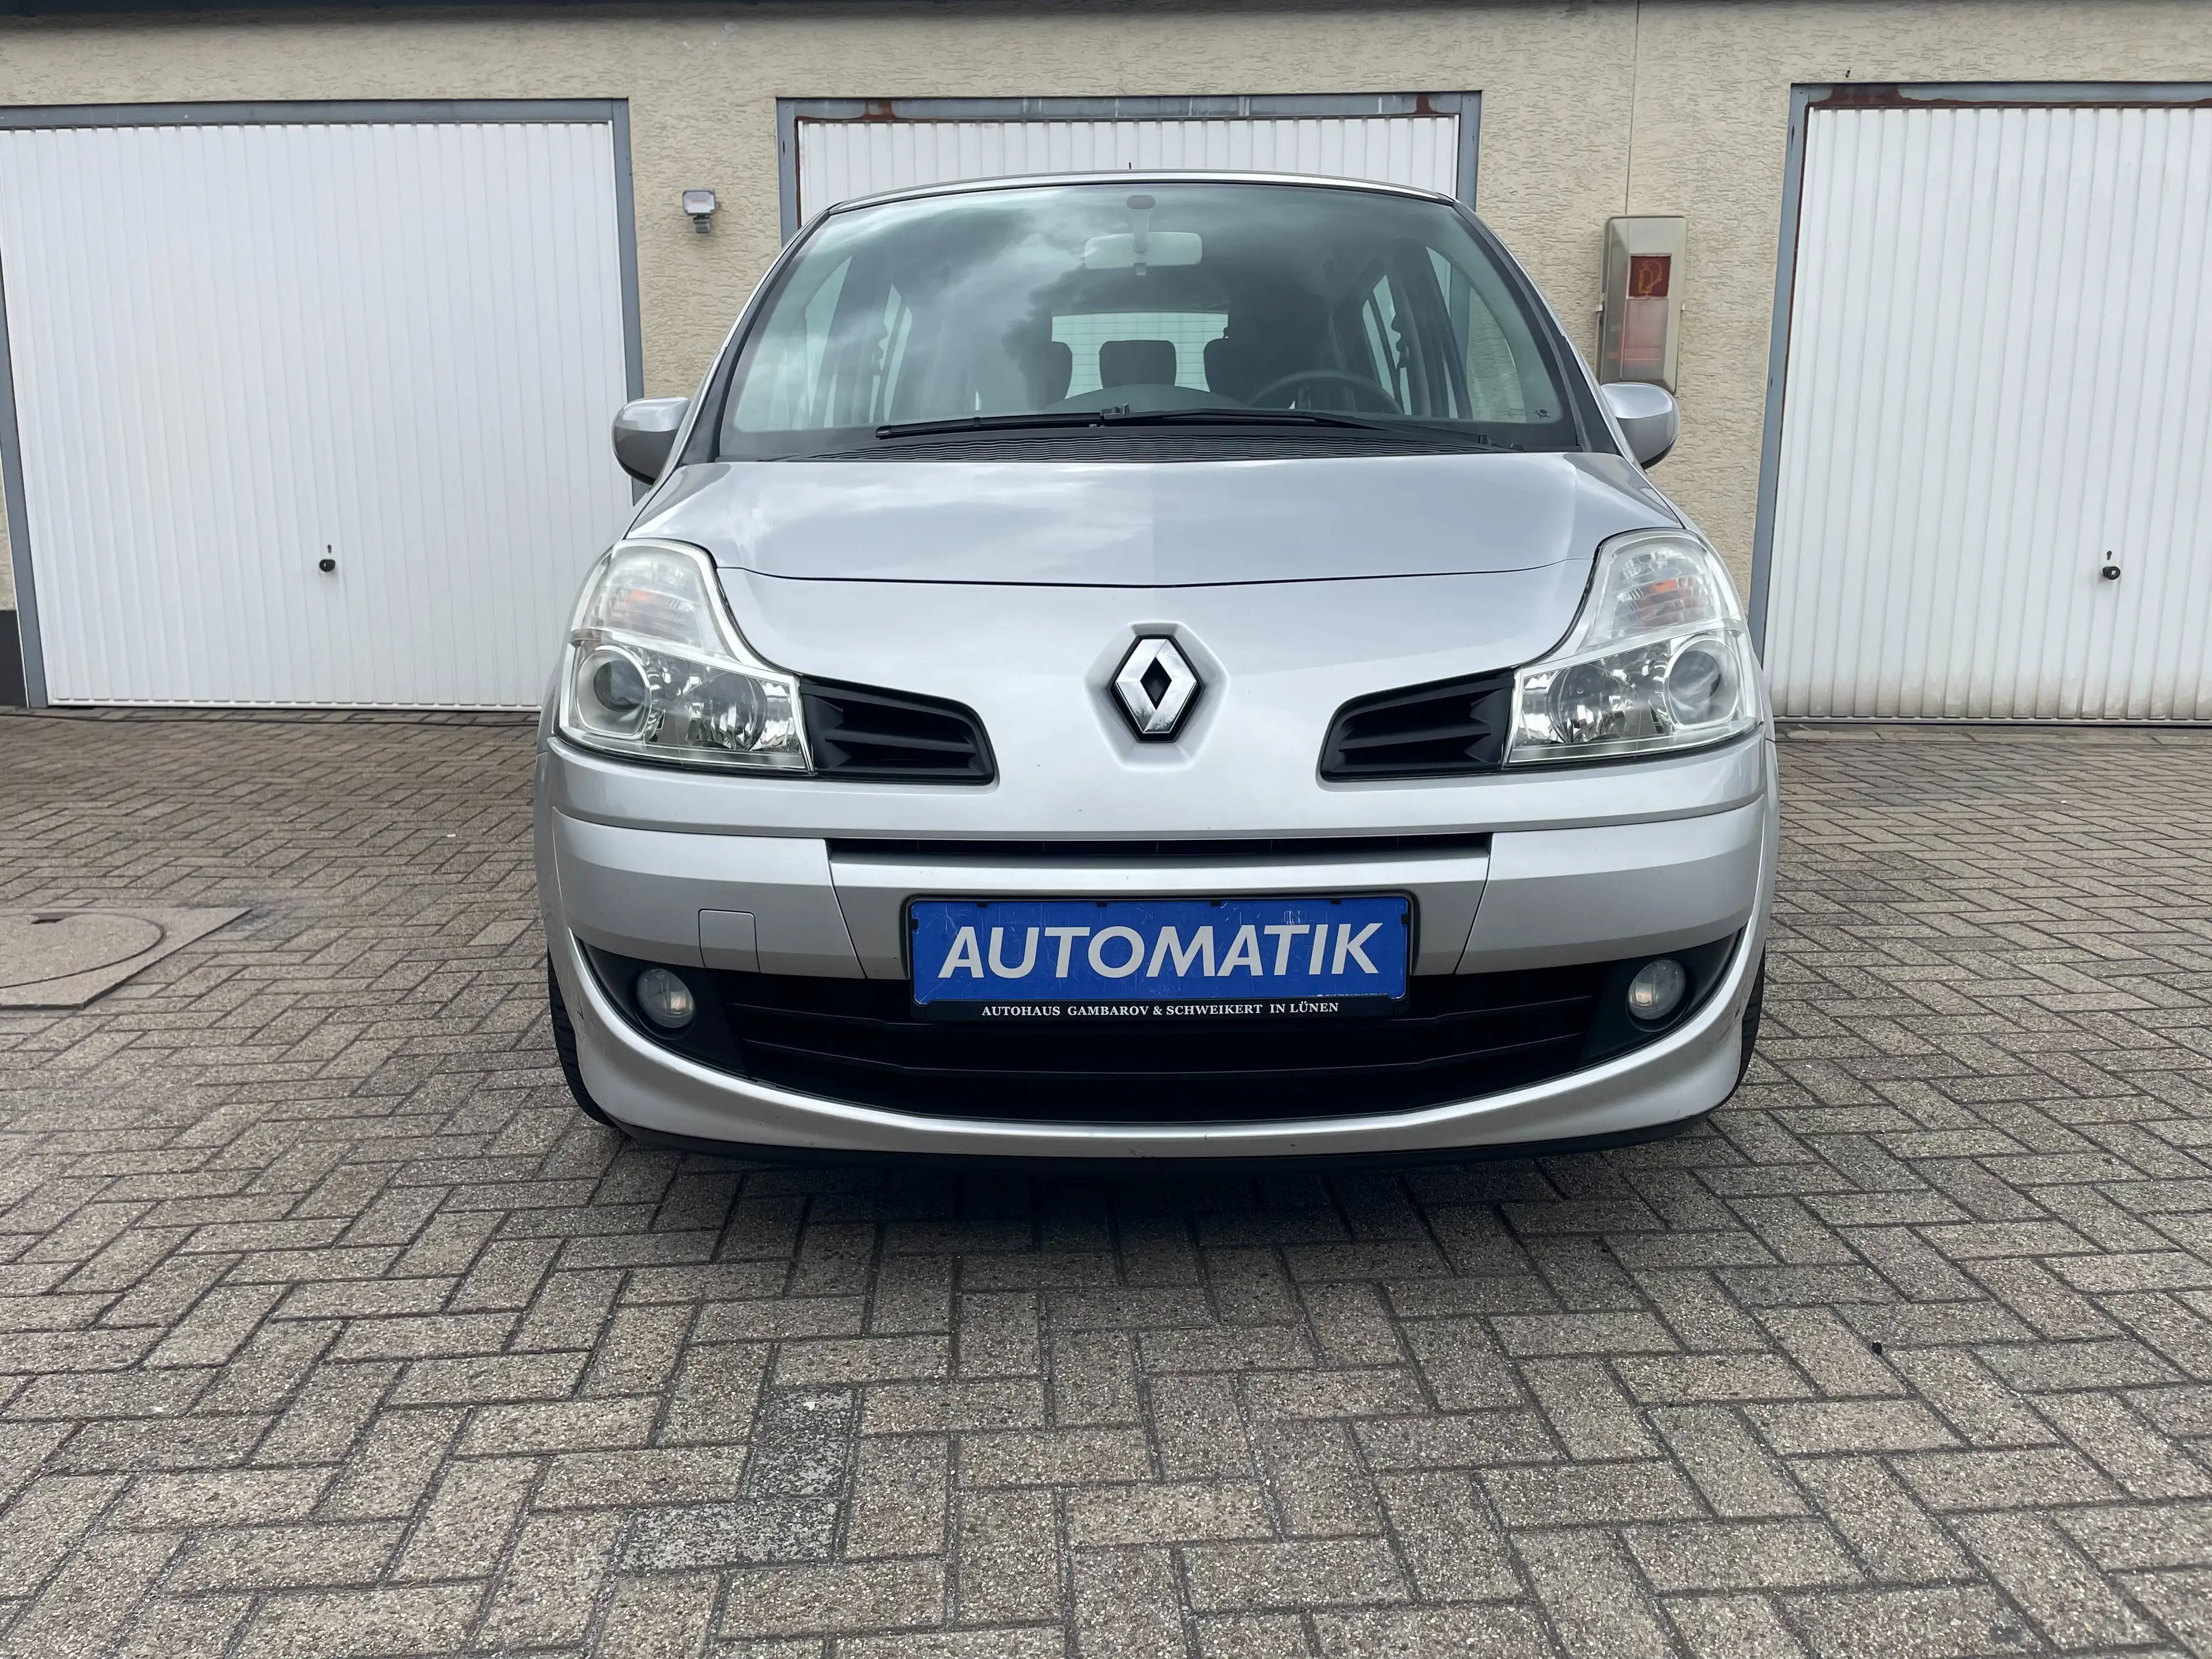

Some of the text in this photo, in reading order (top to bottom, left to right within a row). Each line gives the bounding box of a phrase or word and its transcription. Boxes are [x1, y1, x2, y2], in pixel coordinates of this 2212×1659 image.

[938, 923, 1382, 978] AUTOMATIK
[982, 1001, 1339, 1016] AUTOHAUS GAMBAROV & SCHWEIKERT IN LÜNEN
